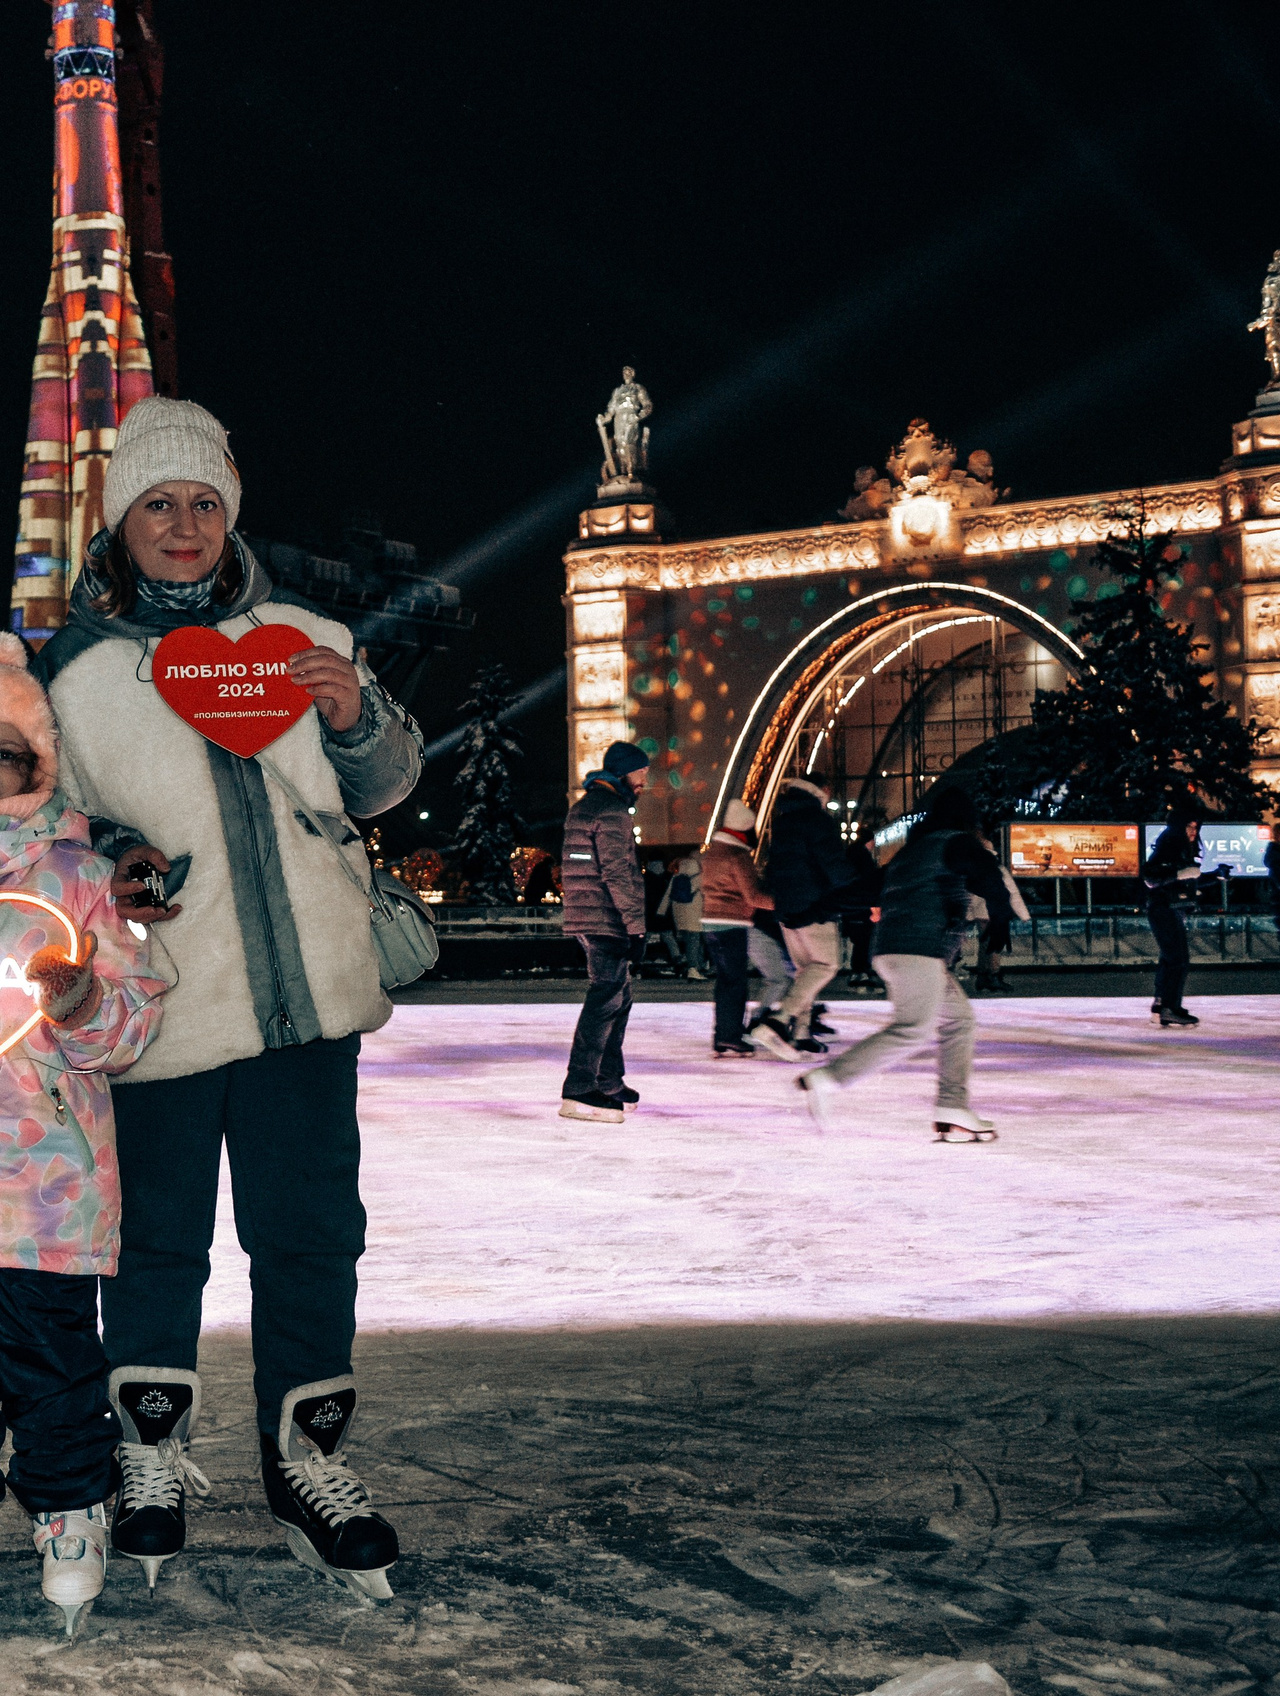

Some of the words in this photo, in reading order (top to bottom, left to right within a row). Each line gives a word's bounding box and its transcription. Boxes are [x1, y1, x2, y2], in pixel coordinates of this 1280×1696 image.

[164, 663, 248, 680] ЛЮБЛЮ
[217, 683, 266, 698] 2024
[193, 709, 290, 719] #ПОЛЮБИЗИМУСЛАДА
